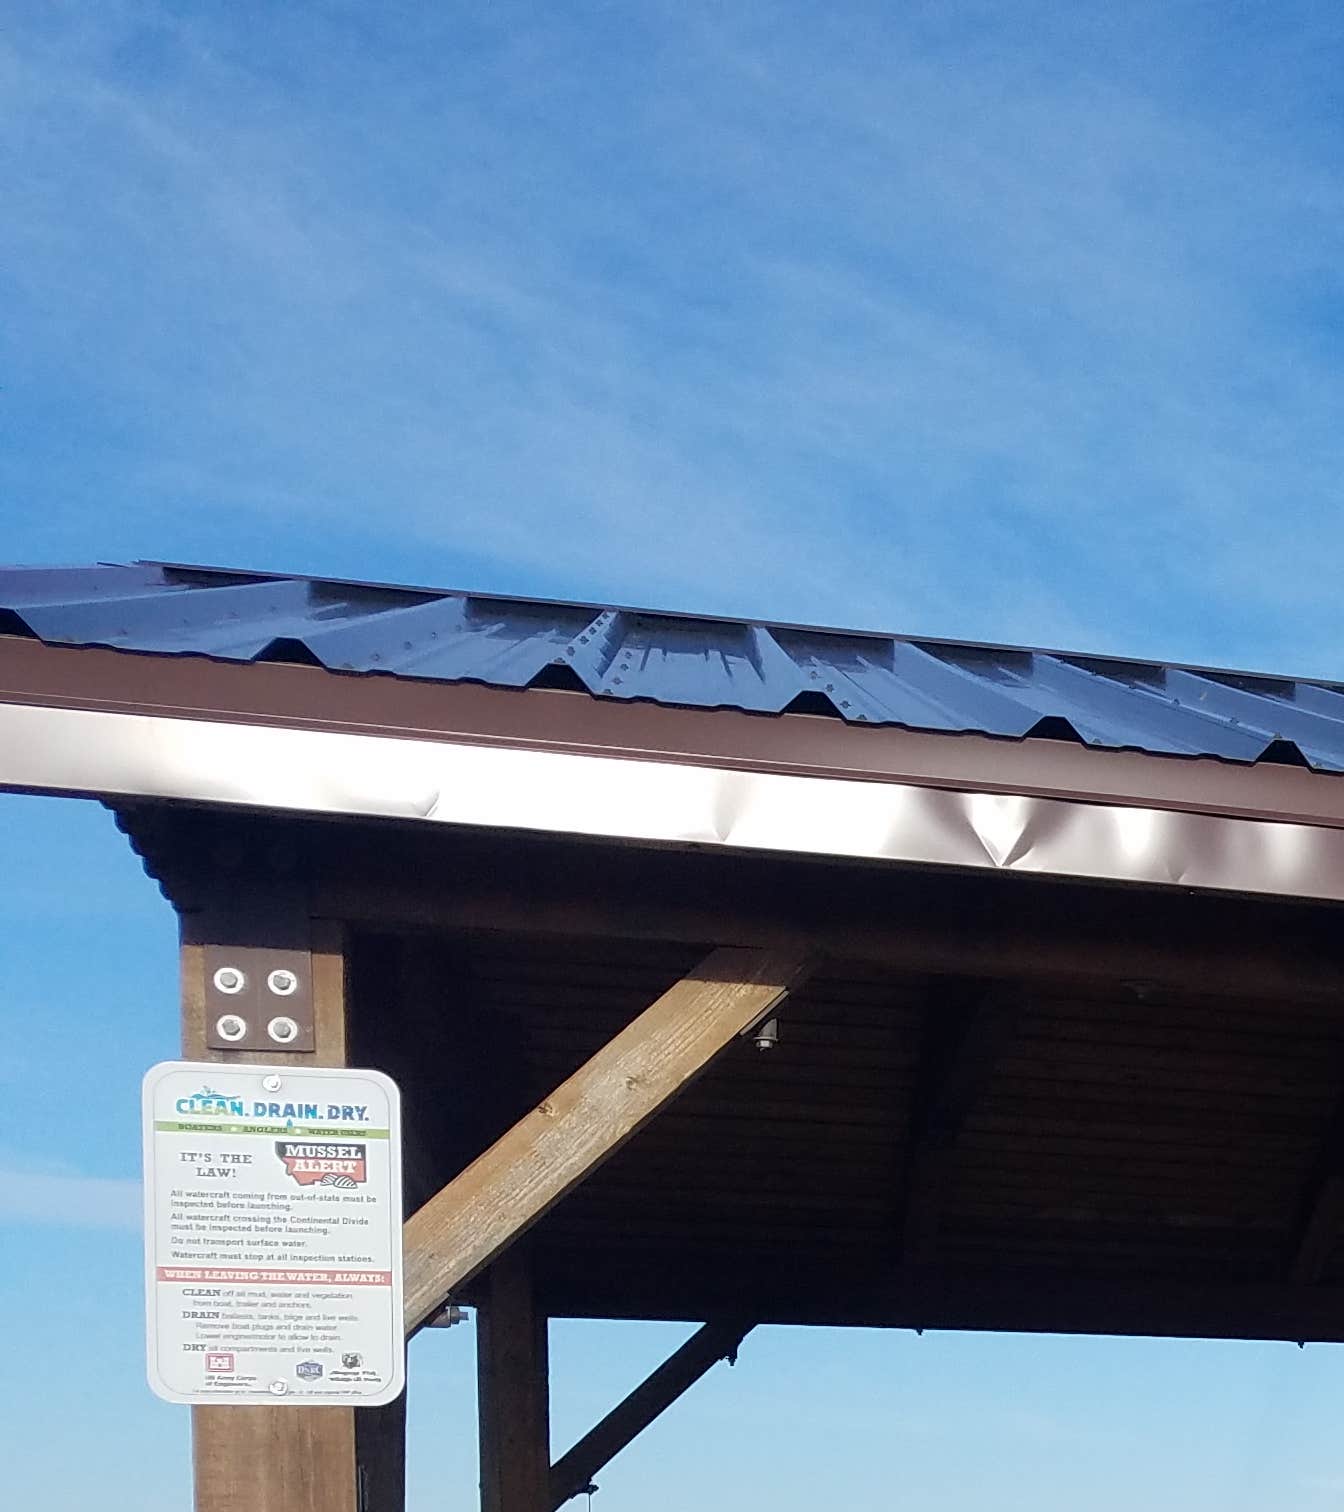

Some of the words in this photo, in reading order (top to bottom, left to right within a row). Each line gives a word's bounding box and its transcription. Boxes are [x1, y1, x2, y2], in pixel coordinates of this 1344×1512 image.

[176, 1099, 250, 1117] CLEAN.
[254, 1102, 323, 1119] DRAIN.
[327, 1105, 369, 1121] DRY.
[285, 1144, 362, 1159] MUSSEL
[180, 1152, 212, 1162] IT'S
[220, 1154, 252, 1164] THE
[293, 1159, 356, 1173] ALERT
[196, 1167, 236, 1177] LAW!
[171, 1190, 182, 1198] All
[185, 1191, 230, 1199] watercraft
[232, 1193, 264, 1201] coming
[290, 1194, 340, 1202] out-of-state
[171, 1200, 214, 1208] inspected
[217, 1201, 245, 1209] before
[248, 1202, 293, 1211] launching.
[186, 1214, 230, 1222] watercraft
[232, 1216, 271, 1224] crossing
[290, 1216, 339, 1225] Continental
[343, 1217, 368, 1225] Divide
[171, 1223, 193, 1231] must
[209, 1224, 252, 1233] inspected
[255, 1225, 282, 1233] before
[285, 1226, 330, 1234] launching.
[203, 1238, 244, 1247] transport
[171, 1251, 217, 1259] Watercraft
[244, 1253, 264, 1261] stop
[290, 1254, 335, 1263] inspection
[338, 1255, 374, 1263] stations.
[165, 1270, 202, 1279] WHEN
[204, 1270, 258, 1280] LEAVING
[260, 1272, 285, 1281] THE
[285, 1273, 331, 1283] WATER,
[334, 1273, 385, 1283] ALWAYS:
[182, 1289, 221, 1297] CLEAN
[182, 1311, 220, 1319] DRAIN
